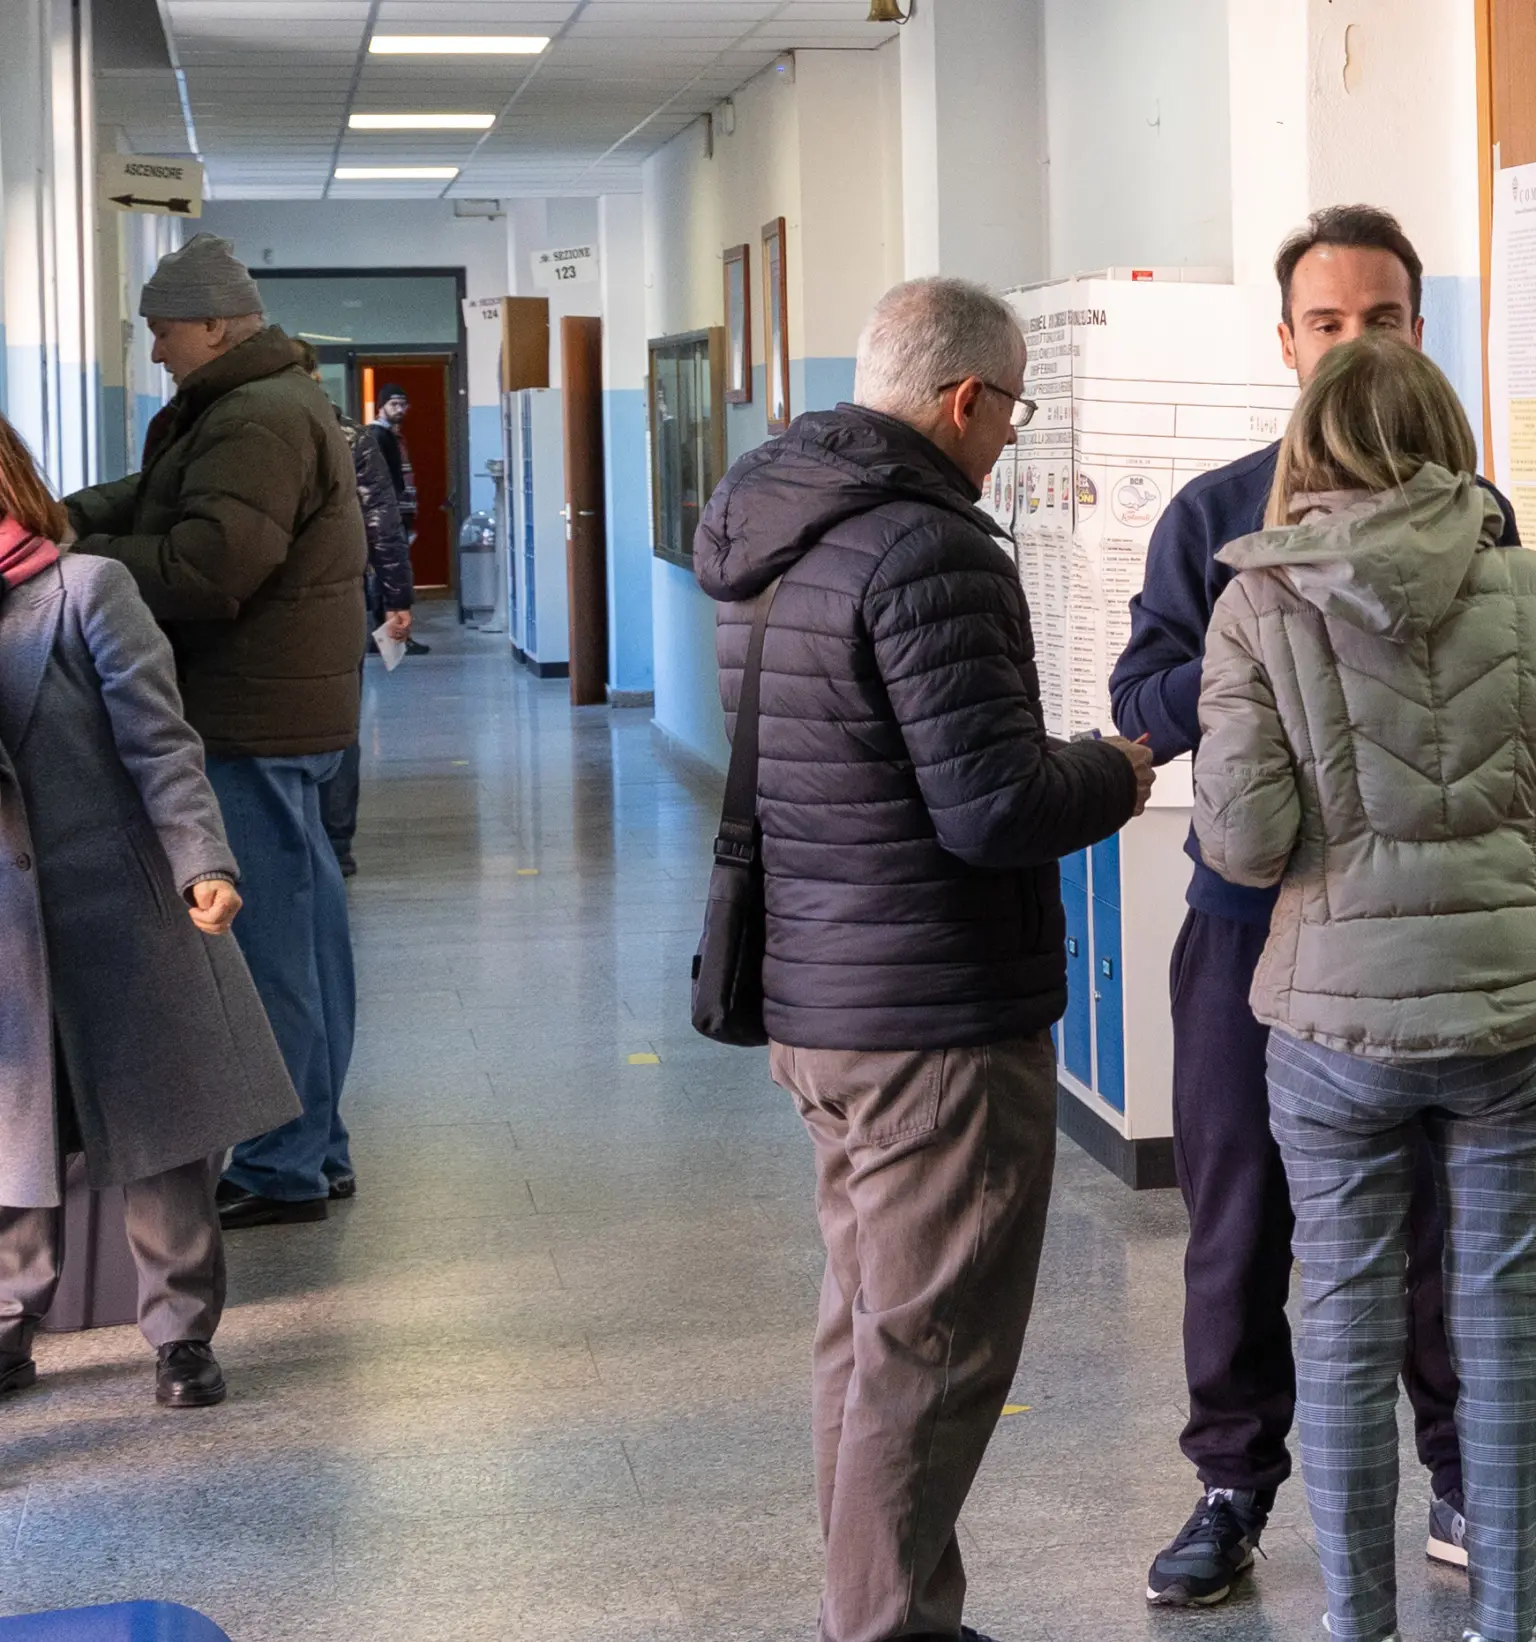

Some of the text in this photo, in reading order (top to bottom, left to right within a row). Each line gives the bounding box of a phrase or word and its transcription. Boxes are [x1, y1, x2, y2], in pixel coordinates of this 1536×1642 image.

[124, 163, 184, 180] ASCENSORE
[552, 247, 591, 262] SEZIONE
[554, 265, 576, 280] 123
[482, 308, 498, 320] 124
